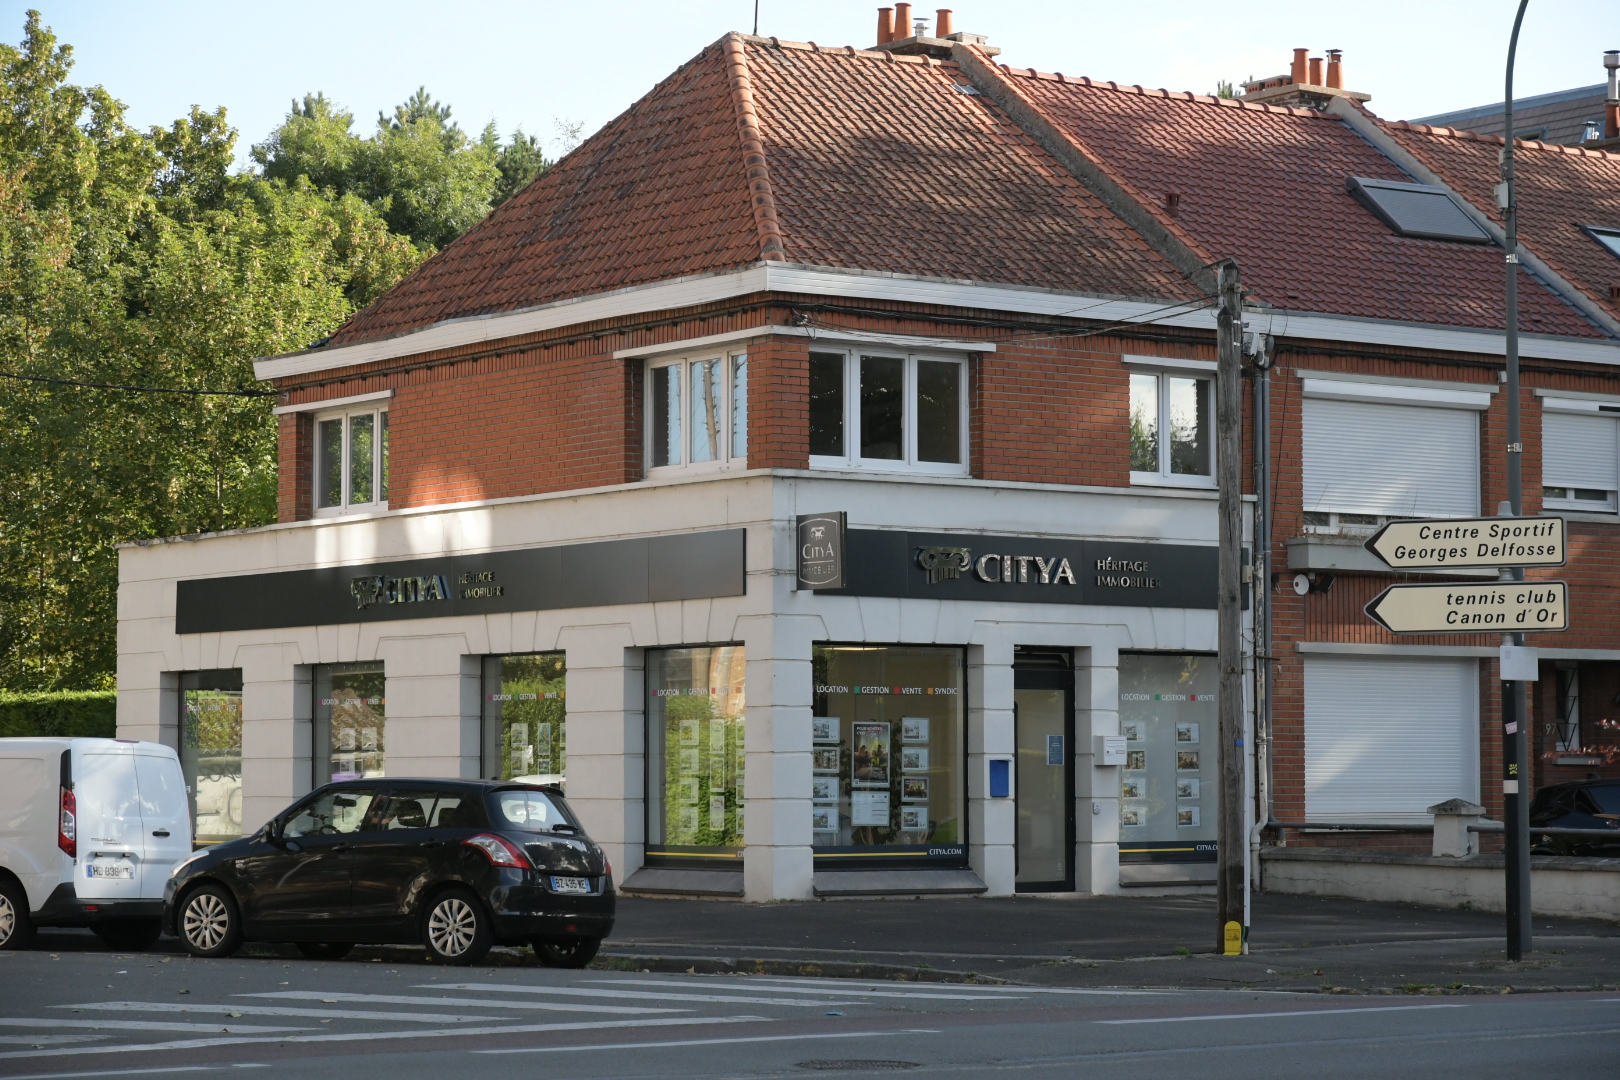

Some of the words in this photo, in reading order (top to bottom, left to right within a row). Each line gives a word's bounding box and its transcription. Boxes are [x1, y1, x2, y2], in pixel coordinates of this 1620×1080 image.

[1419, 525, 1479, 540] Centre
[1488, 522, 1555, 541] Sportif
[802, 541, 834, 559] CITYA
[1394, 545, 1468, 562] Georges
[1476, 542, 1556, 557] Delfosse
[975, 553, 1077, 585] CITYA
[1096, 556, 1149, 572] HÉRITAGE
[1096, 576, 1162, 589] IMMOBILIER
[1446, 590, 1506, 605] tennis
[1516, 589, 1556, 604] club
[1446, 610, 1506, 625] Canon
[657, 689, 680, 697] LOCATION
[816, 685, 849, 693] LOCATION
[861, 686, 890, 694] GESTION
[901, 687, 922, 695] VENTE
[934, 687, 958, 695] SYNDIC
[1121, 693, 1150, 701] LOCATION
[1545, 722, 1557, 735] 97
[929, 848, 962, 856] CITYA.COM
